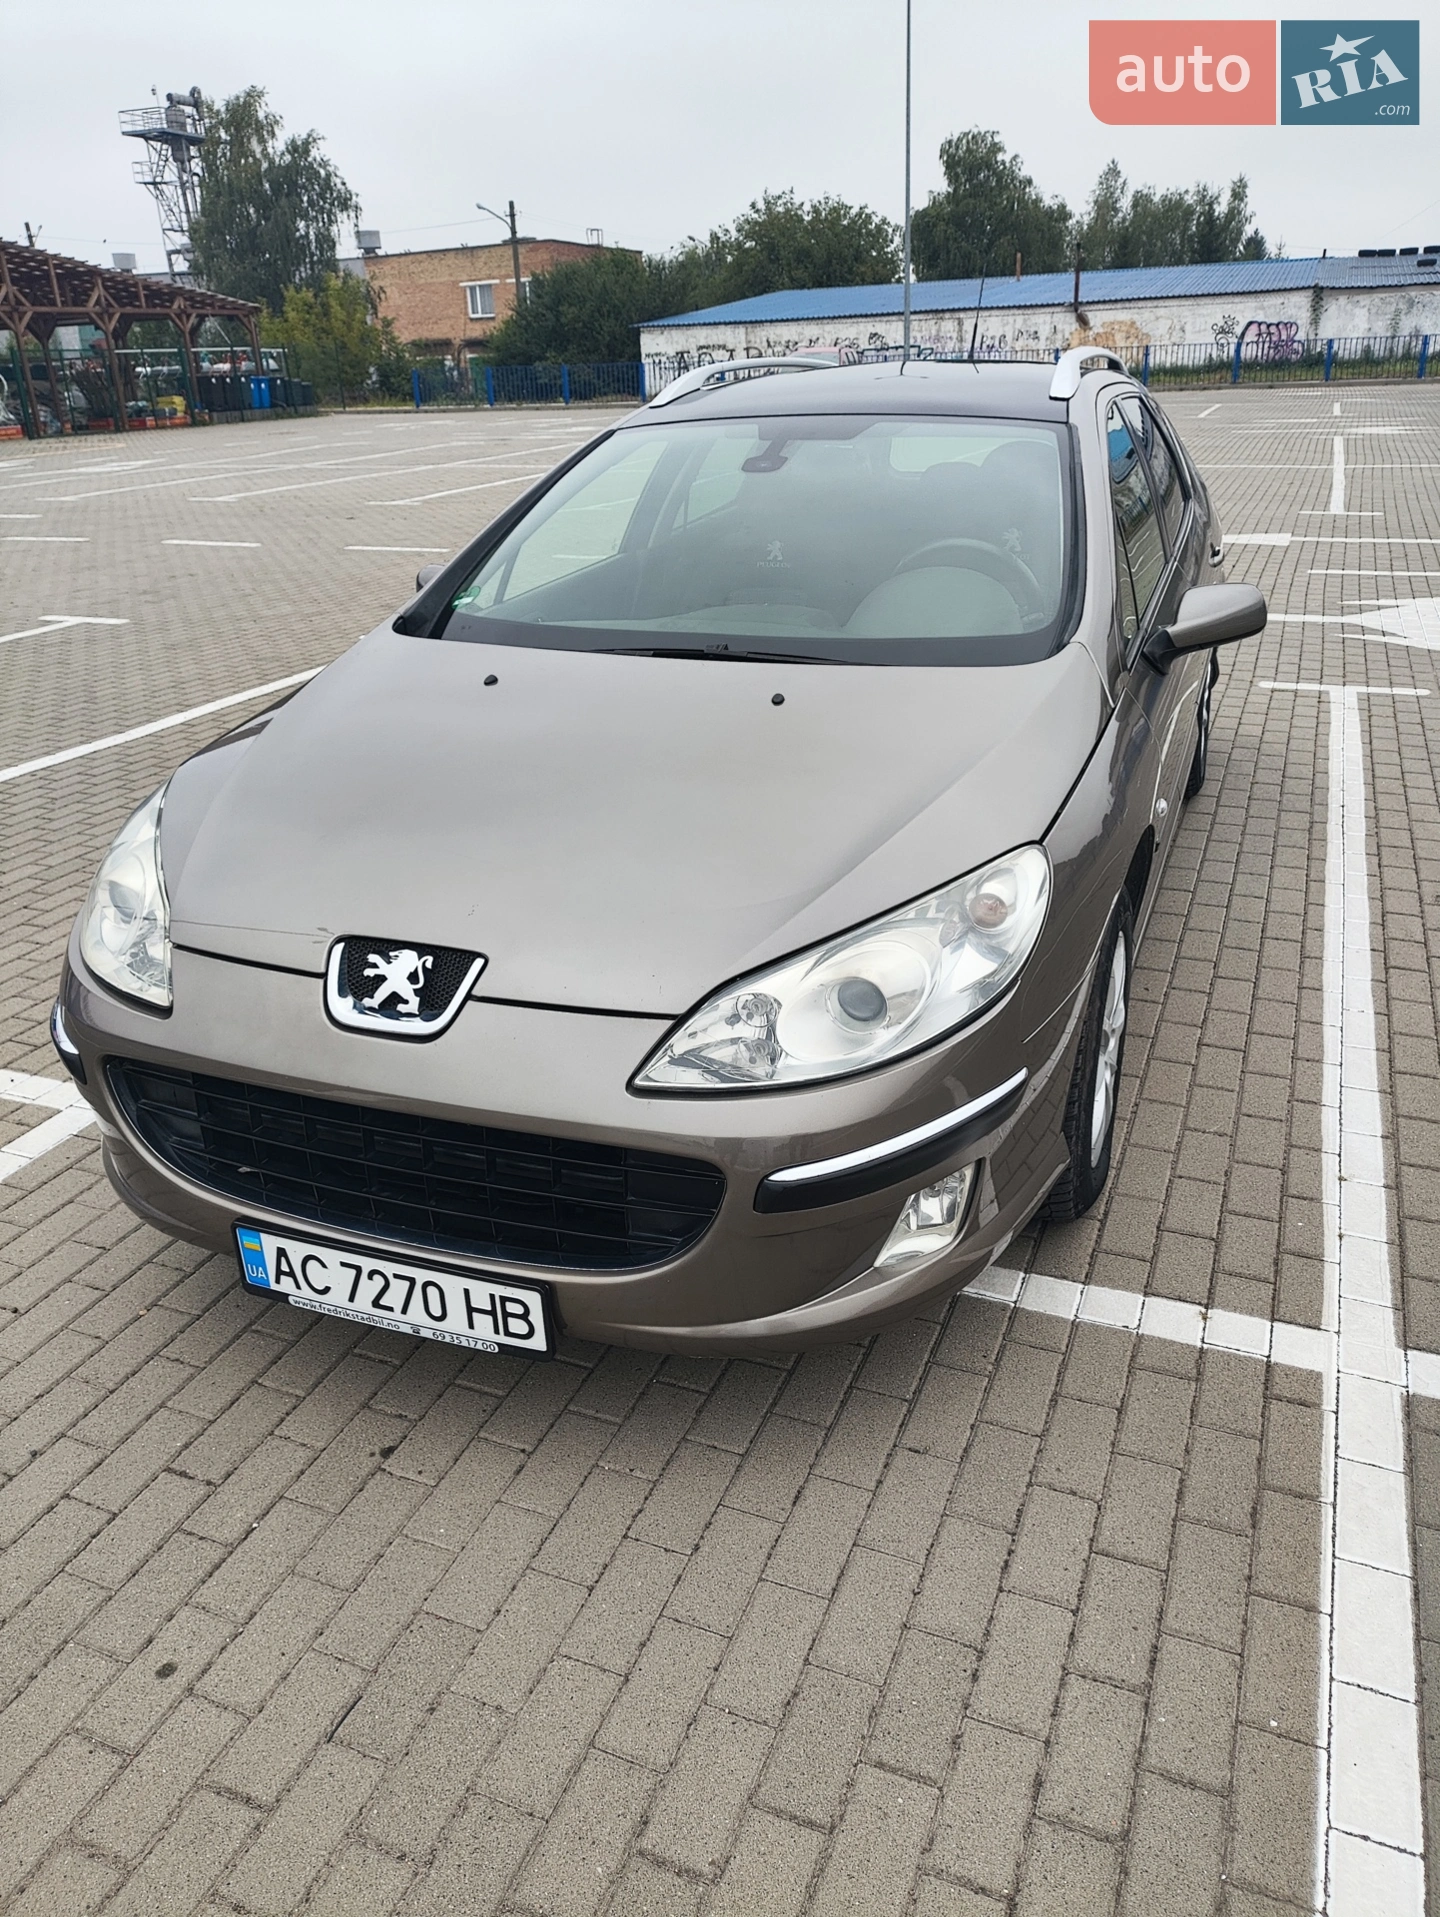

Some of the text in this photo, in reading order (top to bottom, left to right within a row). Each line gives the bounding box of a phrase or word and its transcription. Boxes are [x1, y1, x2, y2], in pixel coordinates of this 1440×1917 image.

[248, 1263, 267, 1280] UA
[274, 1245, 536, 1341] AC 7270 HB
[292, 1298, 496, 1352] www.fredrikstadbil.no 69 35 17 00
